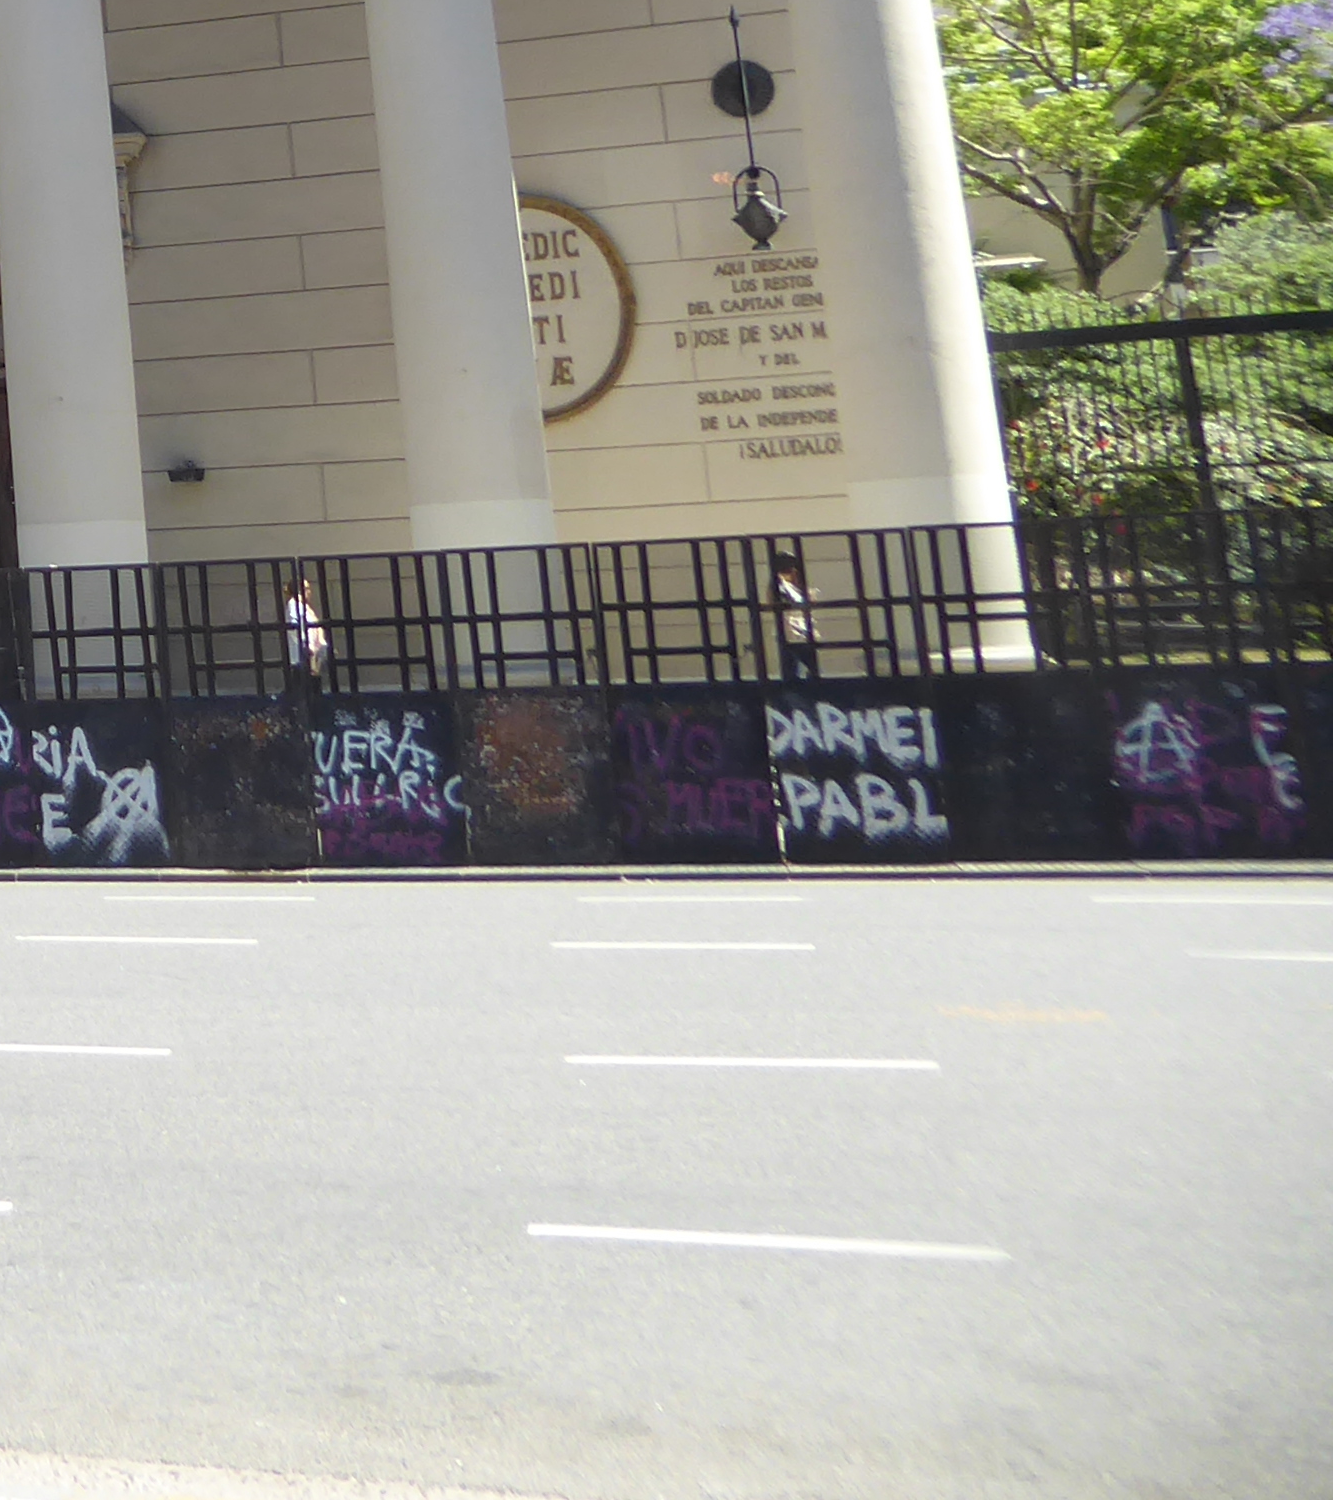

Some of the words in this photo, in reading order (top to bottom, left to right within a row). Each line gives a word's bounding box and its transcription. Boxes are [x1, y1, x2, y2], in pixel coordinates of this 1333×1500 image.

[731, 278, 758, 294] LOS
[763, 274, 814, 291] RESTOS
[687, 301, 714, 316] DEL
[720, 294, 785, 313] CAPITAN
[693, 327, 730, 349] JOSE
[739, 325, 761, 345] DE
[769, 321, 805, 342] SAN
[774, 353, 800, 366] DEL
[698, 387, 762, 405] SOLDADO
[700, 416, 719, 431] DE
[727, 414, 749, 429] LA
